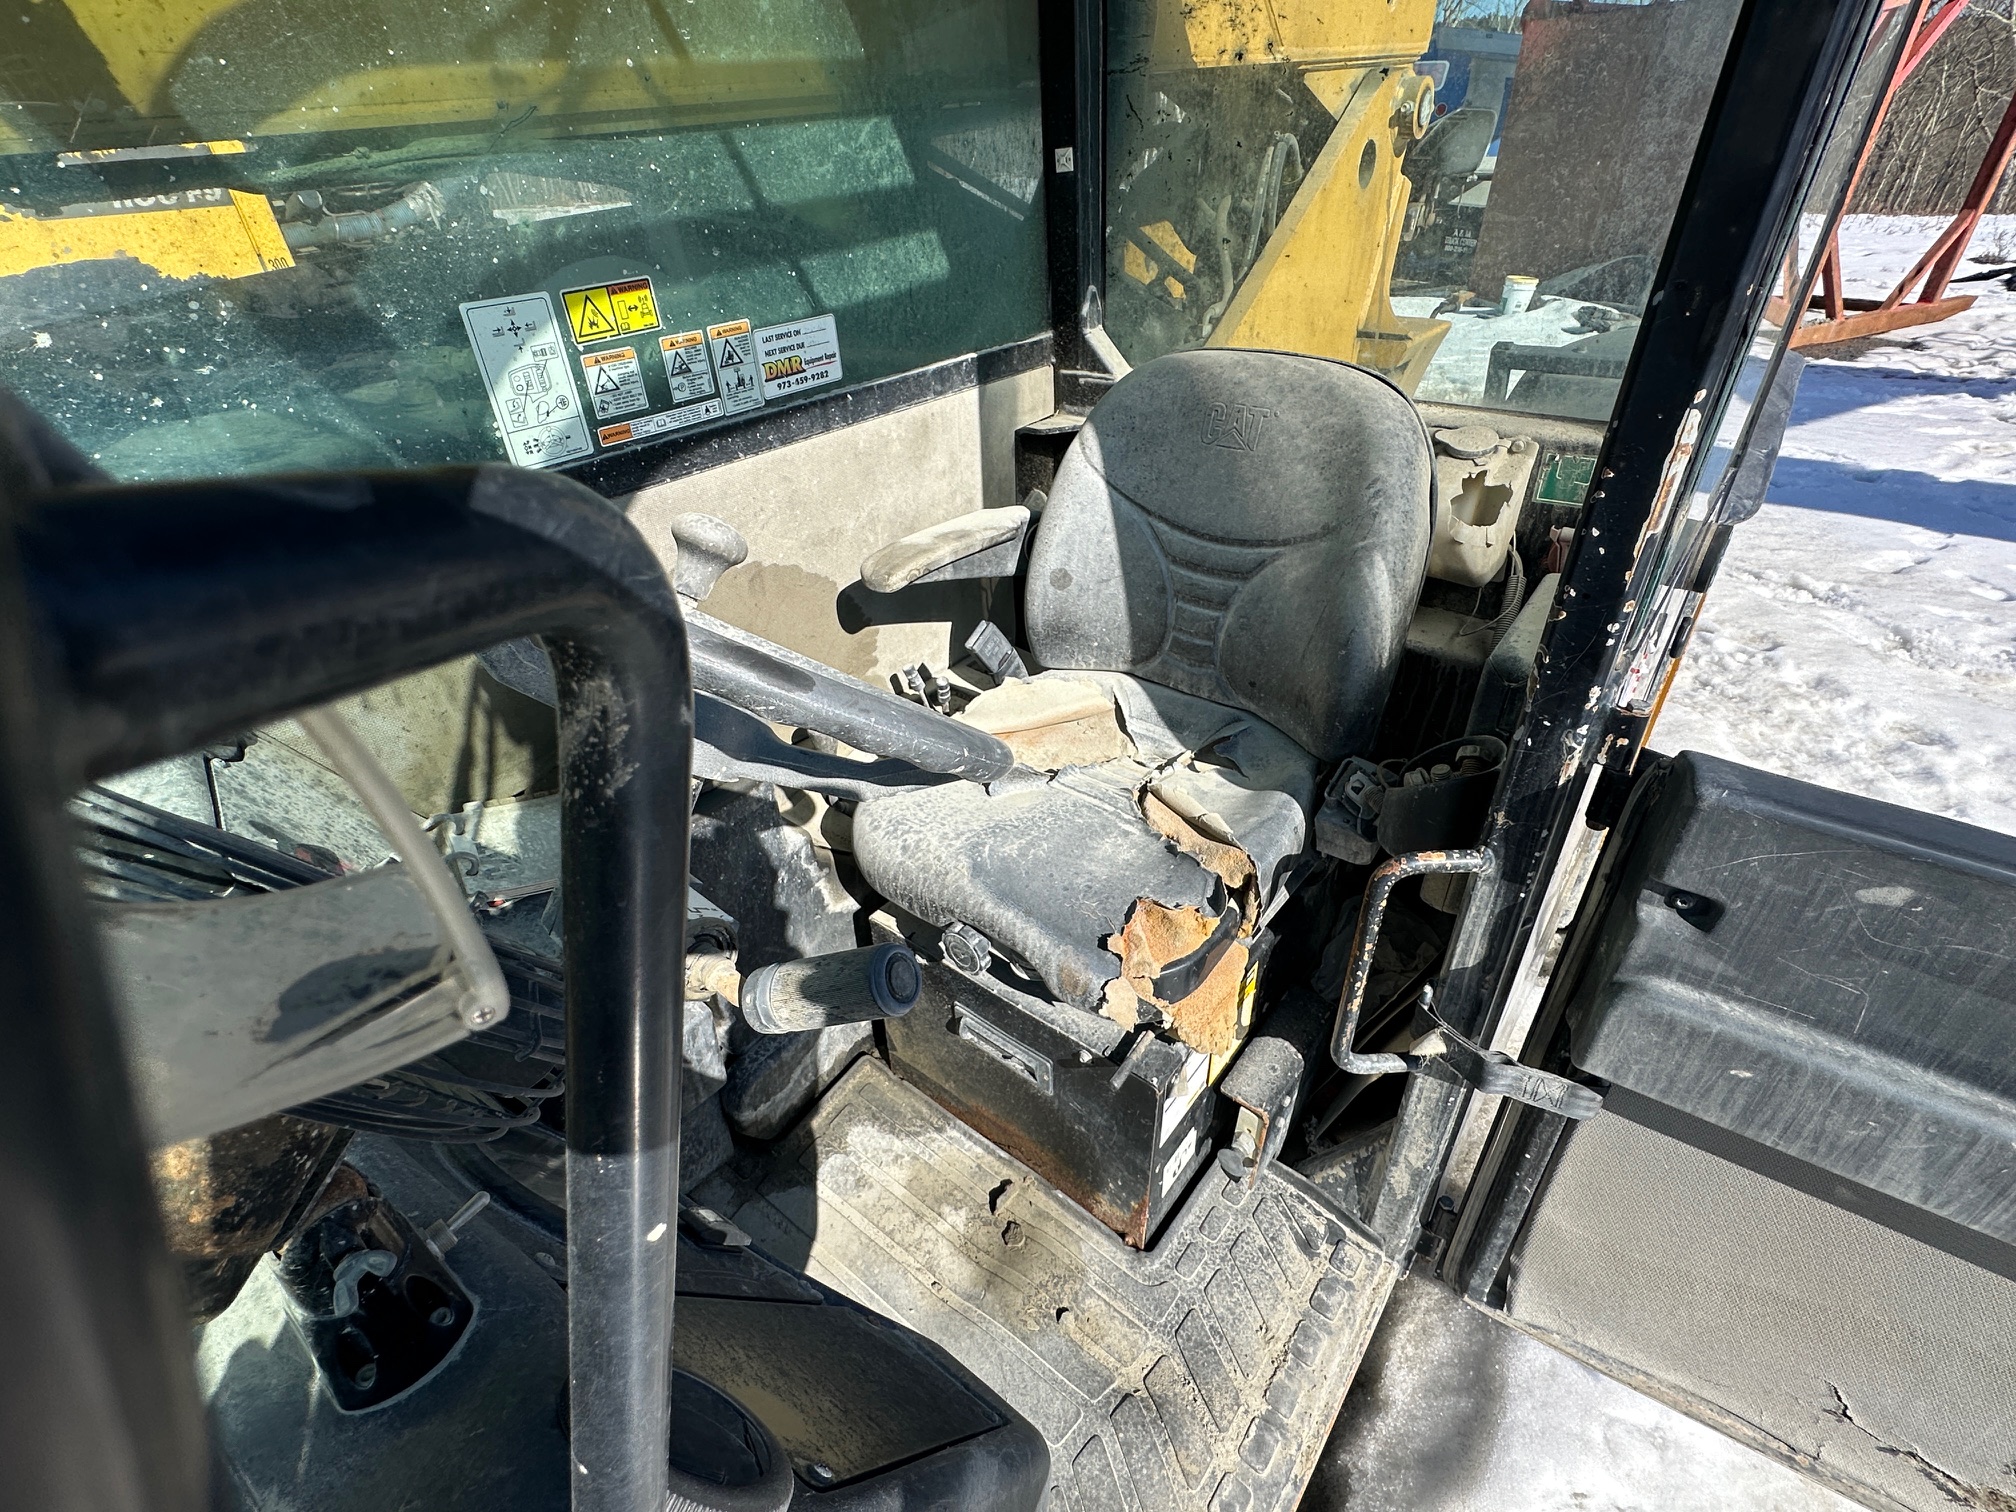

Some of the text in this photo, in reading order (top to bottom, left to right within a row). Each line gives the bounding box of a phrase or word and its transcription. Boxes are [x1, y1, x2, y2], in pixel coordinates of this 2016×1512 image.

[618, 282, 648, 293] WARNING
[722, 325, 743, 334] WARNING
[675, 336, 698, 345] WRNING
[762, 329, 802, 344] LAST SERVICE ON
[764, 342, 805, 358] NEXT SERVICE DUE
[600, 352, 625, 362] WARNING
[762, 351, 837, 382] DMR Equipment Repair
[777, 370, 829, 390] 973-459-9282
[608, 428, 630, 438] WARNING
[1201, 402, 1270, 452] CAT
